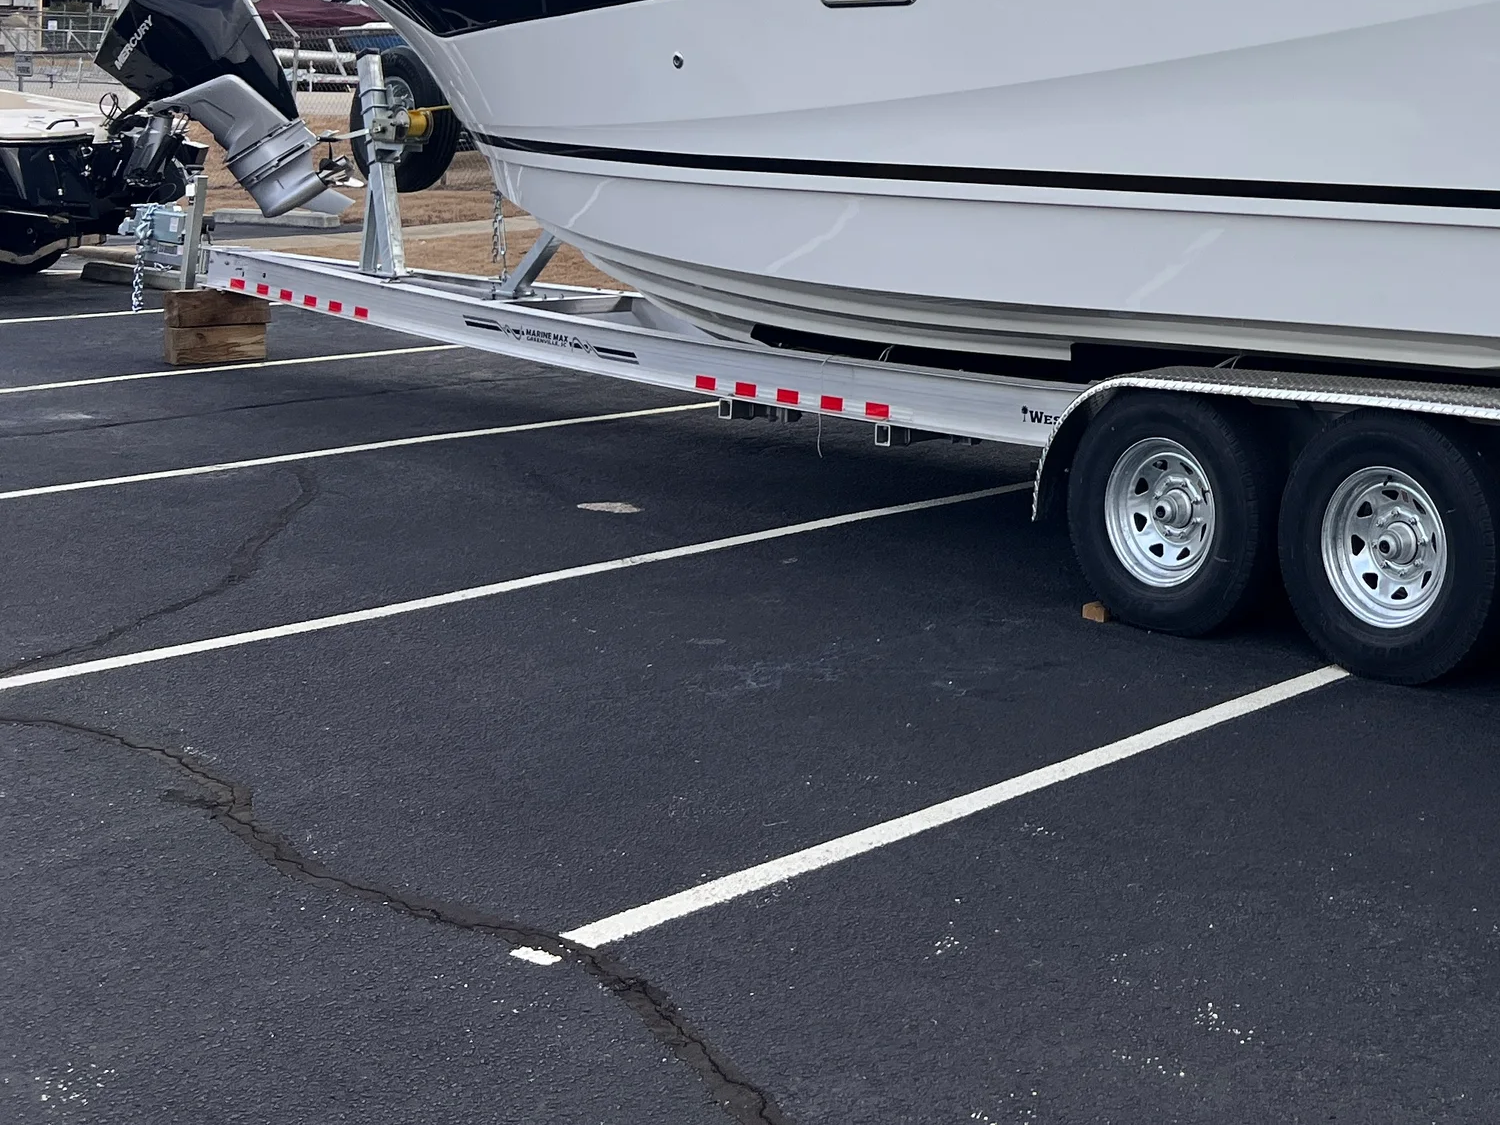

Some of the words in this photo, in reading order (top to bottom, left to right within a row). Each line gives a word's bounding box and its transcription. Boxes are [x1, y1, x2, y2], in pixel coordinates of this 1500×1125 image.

[114, 14, 153, 71] MERCURY
[525, 328, 552, 340] MARINE
[552, 333, 569, 343] MAX
